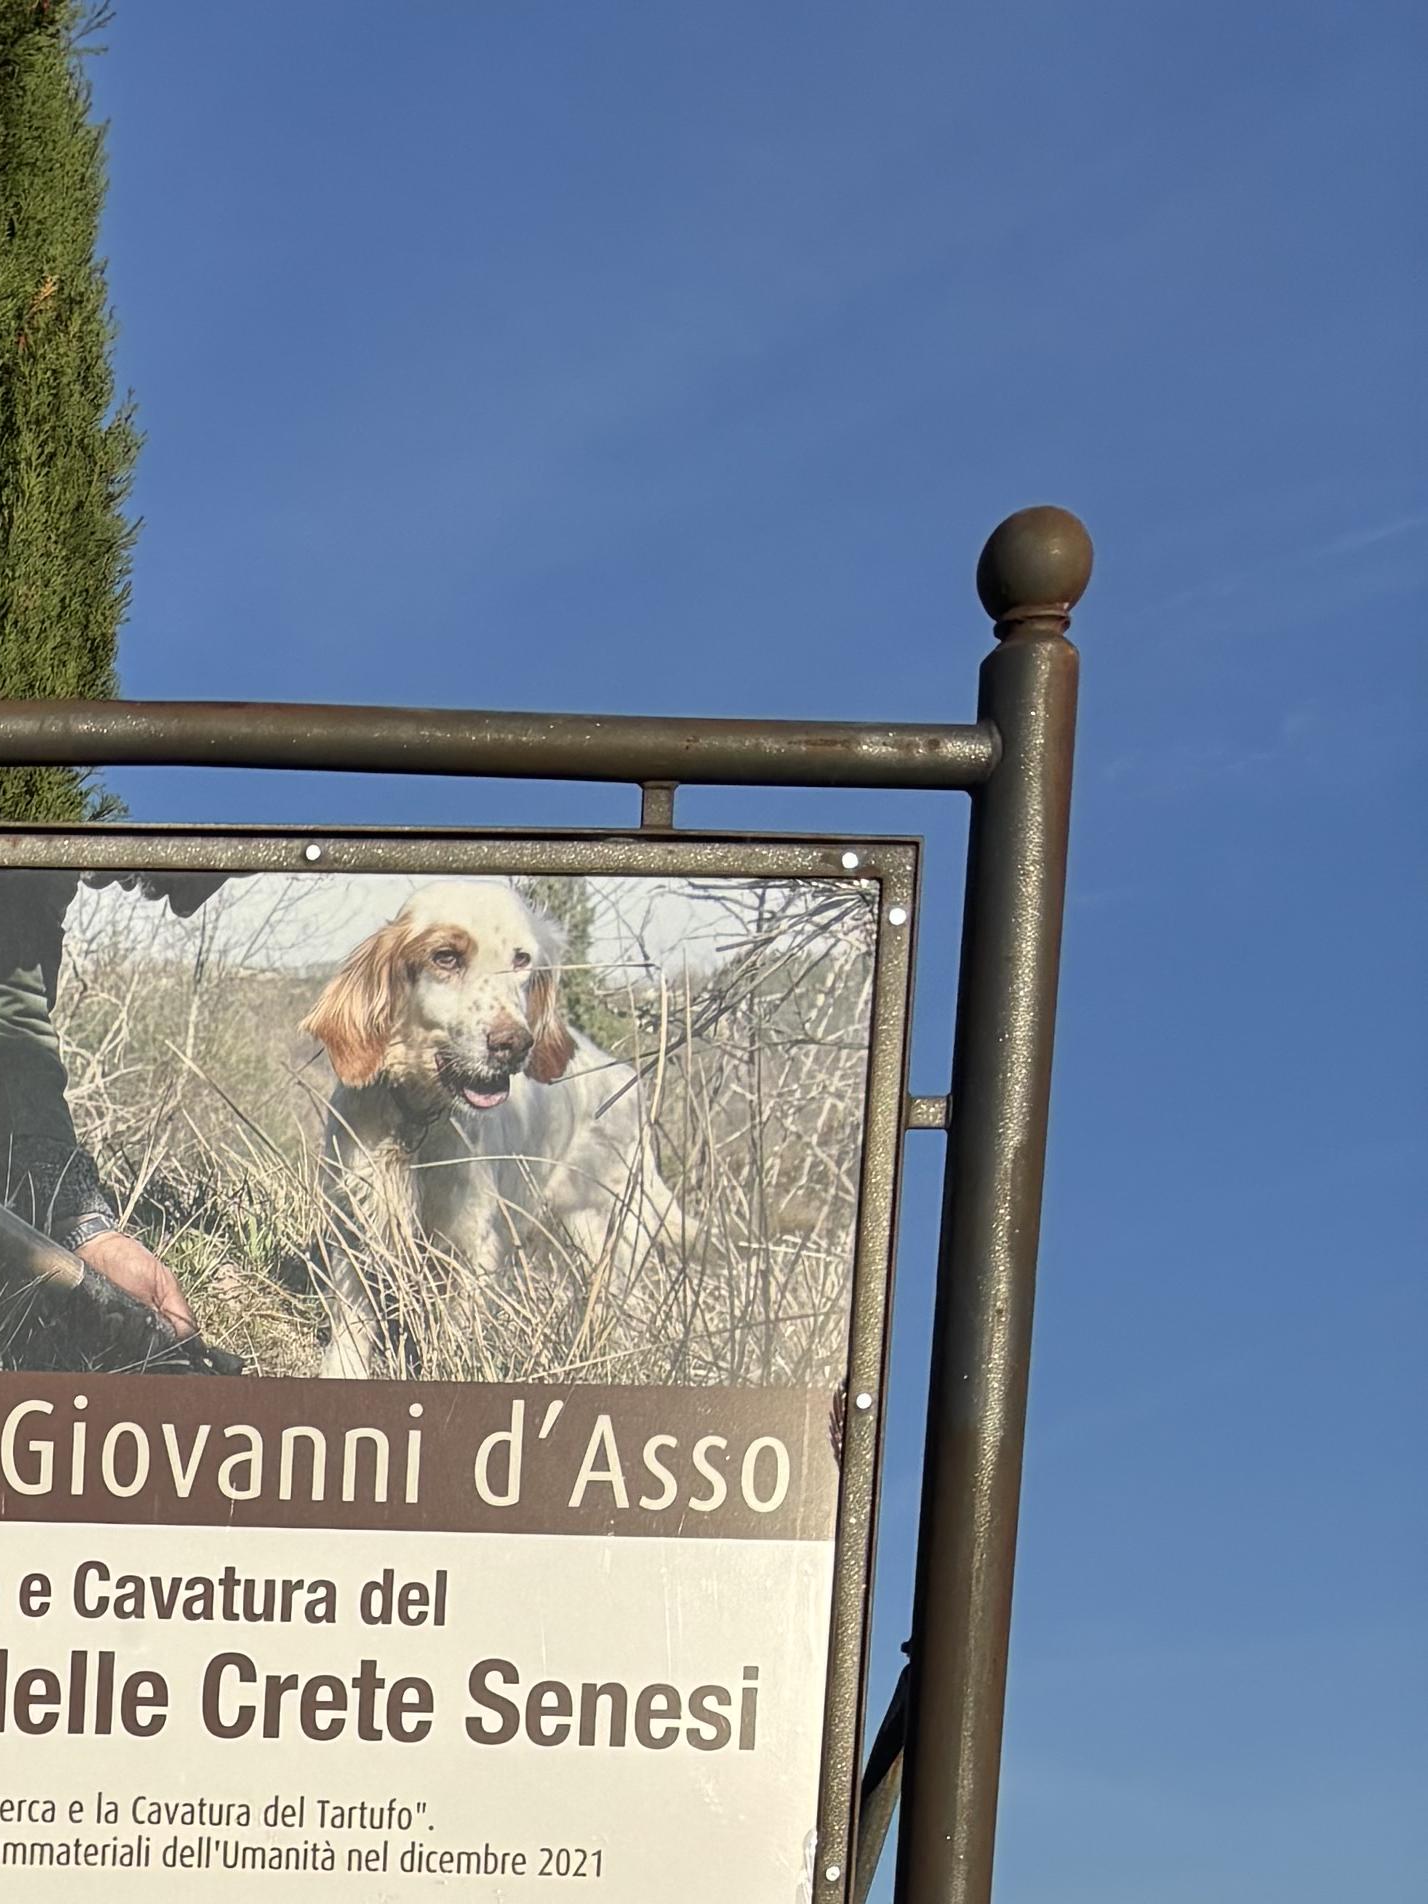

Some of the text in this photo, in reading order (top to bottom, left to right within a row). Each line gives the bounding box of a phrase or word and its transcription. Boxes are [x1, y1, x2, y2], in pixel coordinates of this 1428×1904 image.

[0, 1395, 423, 1506] Giovanni
[474, 1407, 802, 1512] d'Asso
[19, 1572, 51, 1617] e
[73, 1560, 336, 1624] Cavatura
[360, 1568, 447, 1626] del
[202, 1652, 433, 1743] Crete
[465, 1658, 759, 1751] Senesi
[68, 1800, 83, 1823] e
[96, 1791, 118, 1824] la
[131, 1796, 251, 1827] Cavatura
[264, 1795, 304, 1828] del
[316, 1797, 433, 1830] Tartufo".
[162, 1835, 334, 1871] dell'Umanità
[347, 1840, 388, 1872] nel
[400, 1840, 526, 1875] dicembre
[538, 1847, 601, 1877] 2021
